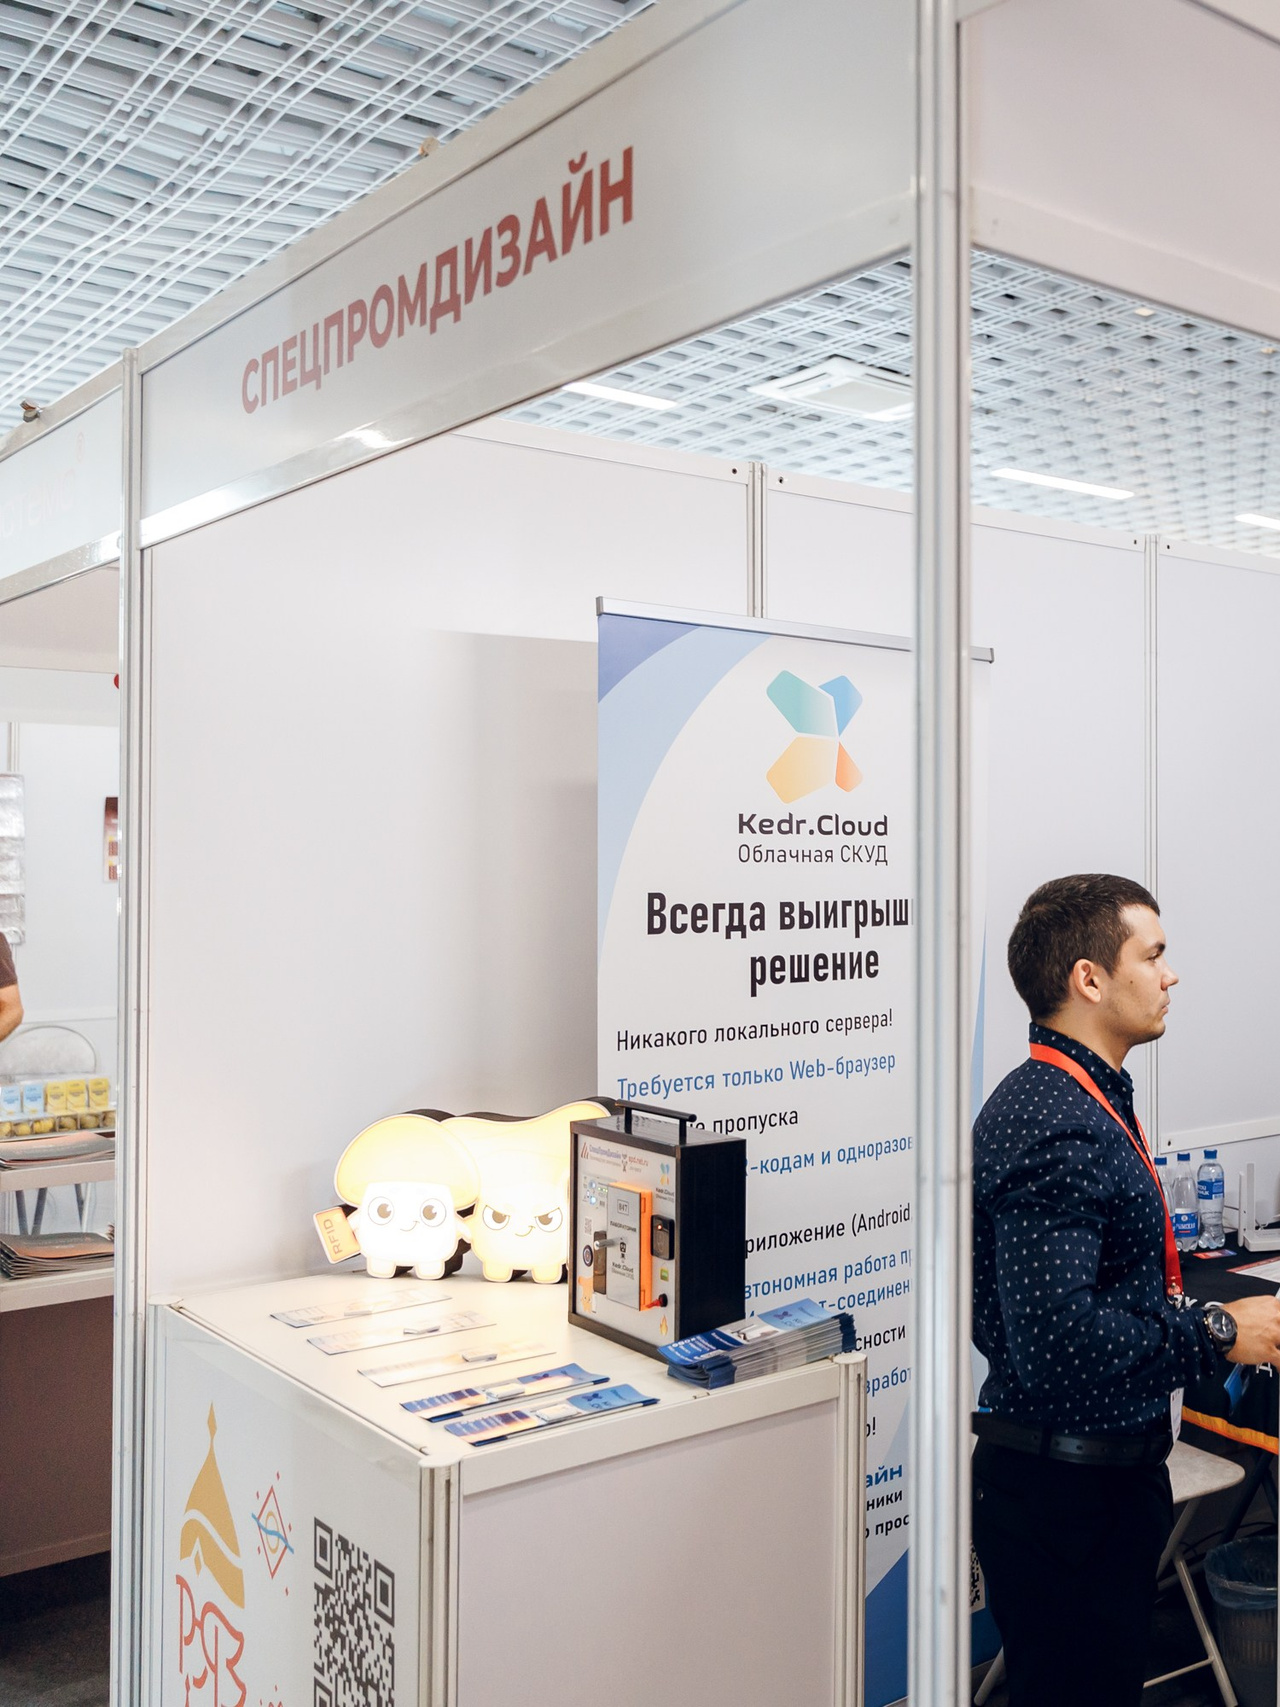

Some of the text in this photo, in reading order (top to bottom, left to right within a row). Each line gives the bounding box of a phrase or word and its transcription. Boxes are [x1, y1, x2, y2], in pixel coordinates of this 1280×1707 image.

[241, 145, 633, 414] СПЕЦПРОМДИЗАЙН
[738, 812, 889, 837] Kedr.Cloud
[738, 844, 889, 866] Облачная СКУД
[647, 892, 913, 940] Всегда выигрыш
[750, 949, 880, 998] решение
[617, 1009, 893, 1051] Никакого локального сервера!
[617, 1053, 896, 1101] Требуется только Web-браузер
[713, 1110, 799, 1135] пропуска
[745, 1152, 815, 1176] -кодам
[821, 1150, 831, 1165] и
[323, 1218, 342, 1255] RFID
[745, 1222, 845, 1259] риложение
[745, 1267, 838, 1299] втономная
[844, 1255, 896, 1284] работа
[819, 1279, 912, 1311] т-соединен
[855, 1325, 906, 1352] сности
[866, 1367, 911, 1397] зработ
[866, 1464, 902, 1489] айн
[866, 1490, 903, 1512] ники
[875, 1514, 910, 1536] прос
